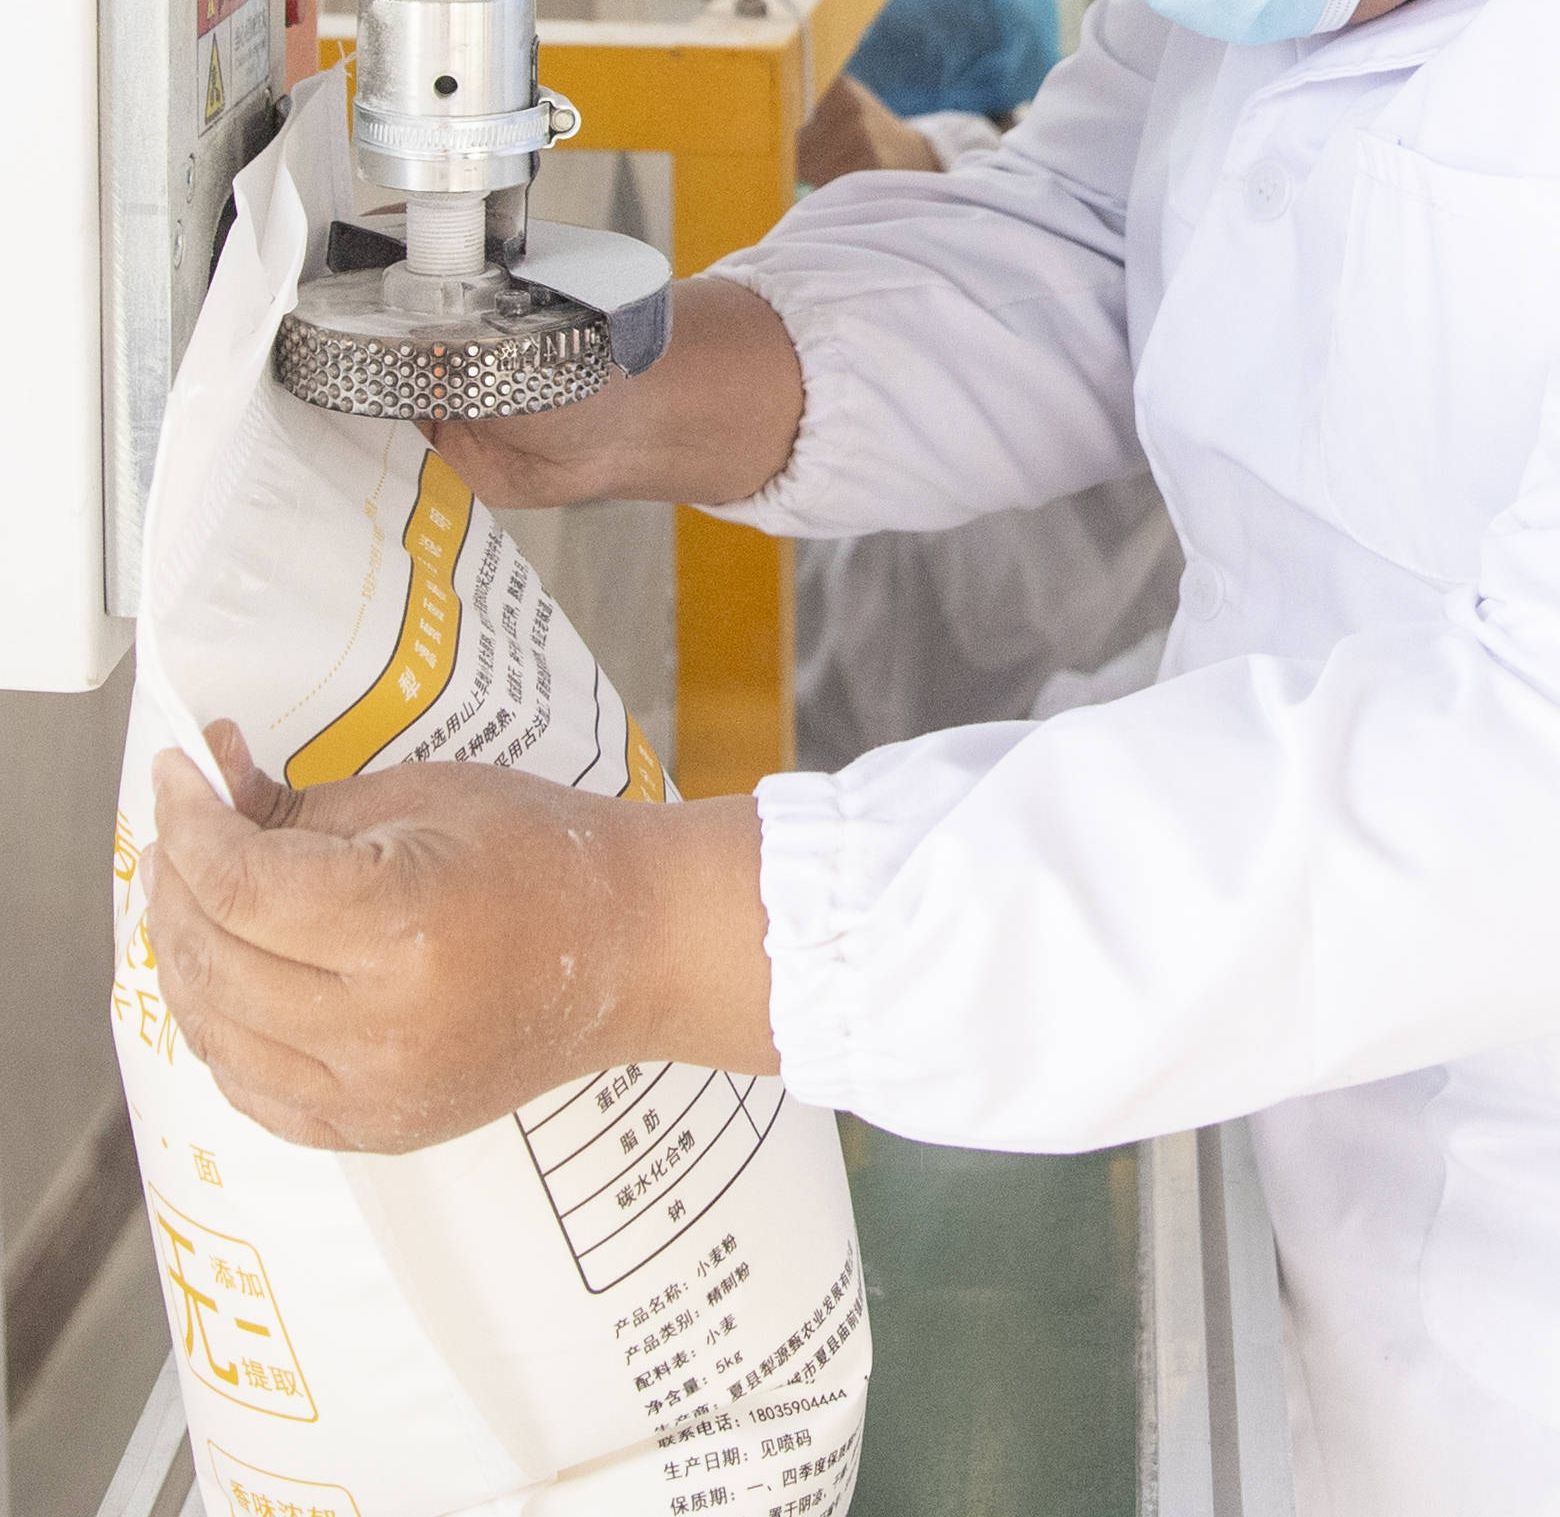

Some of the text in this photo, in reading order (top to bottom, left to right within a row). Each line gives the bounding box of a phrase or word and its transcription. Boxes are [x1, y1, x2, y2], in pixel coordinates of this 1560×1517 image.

[595, 1063, 643, 1114] 蛋白质
[619, 1109, 661, 1154] 脂肪
[615, 1129, 696, 1210] 碳水化合物
[667, 1199, 687, 1223] 钠
[208, 1254, 265, 1298] 添加
[157, 1212, 238, 1386] 无
[241, 1357, 304, 1397] 提取
